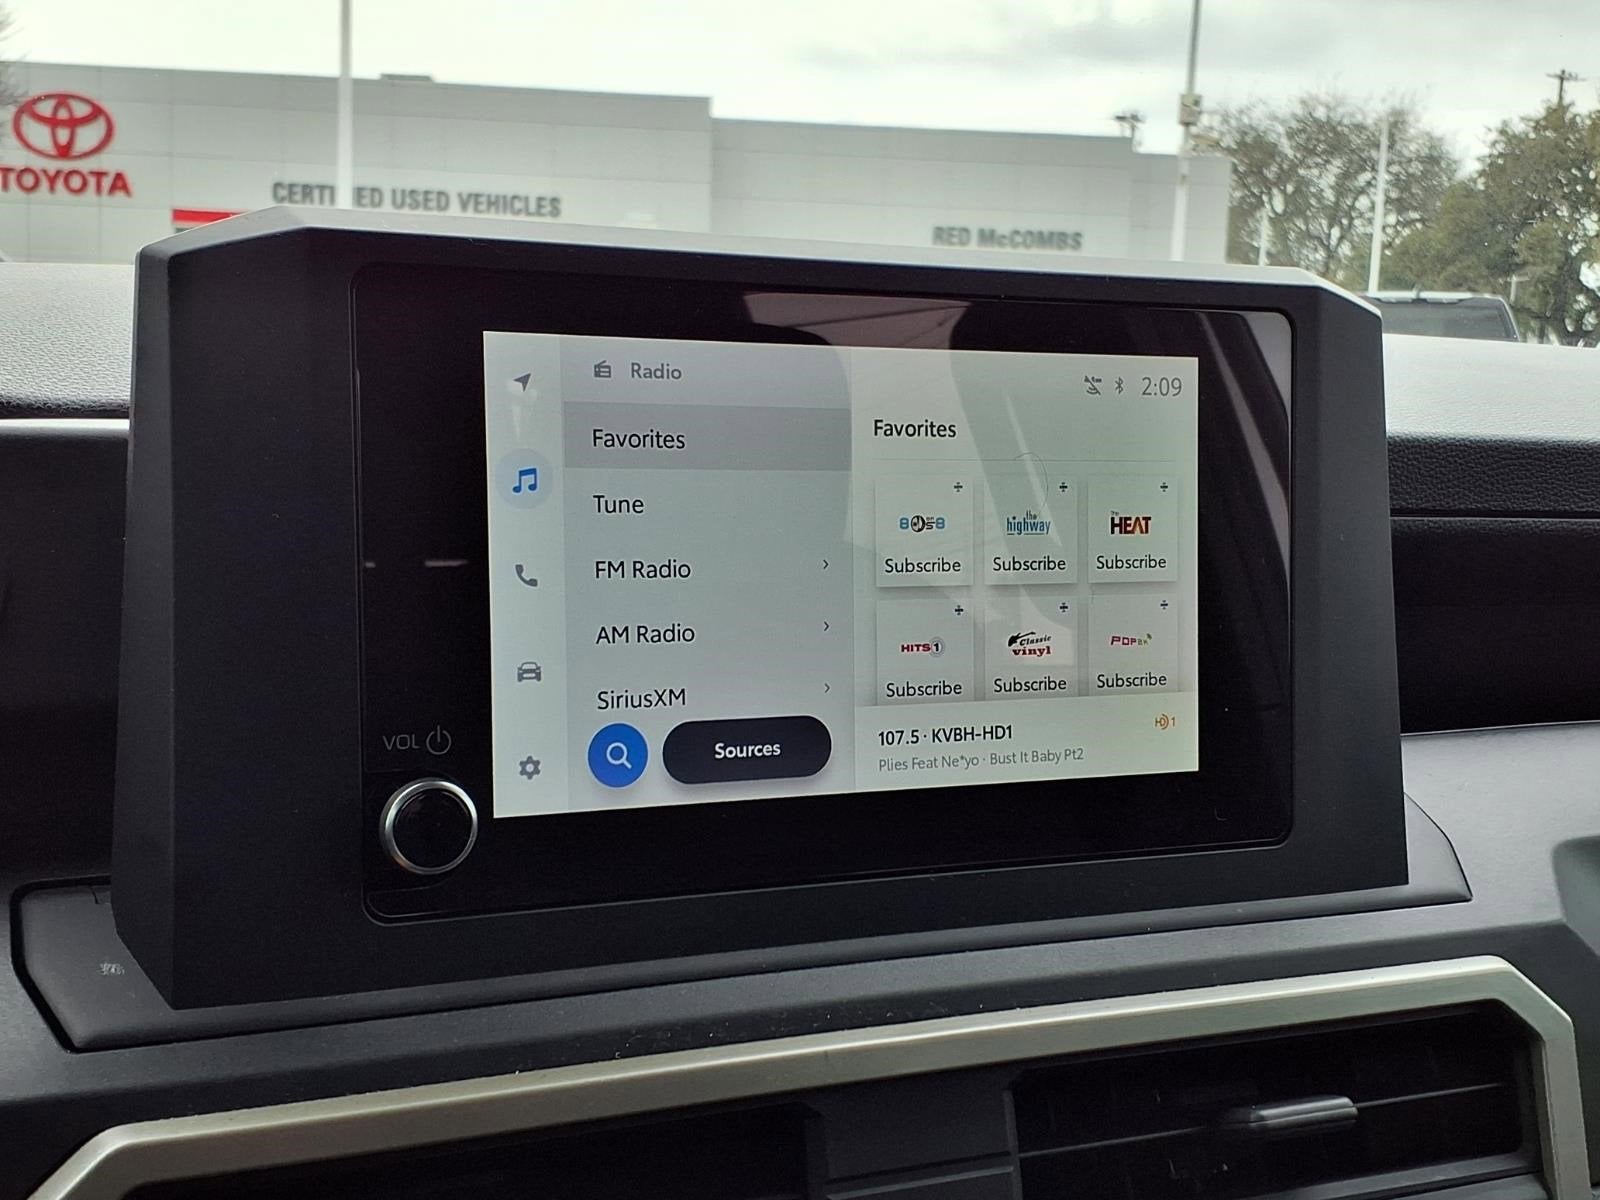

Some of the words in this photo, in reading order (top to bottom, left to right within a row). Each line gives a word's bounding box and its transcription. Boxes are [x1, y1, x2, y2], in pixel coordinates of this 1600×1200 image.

[0, 166, 132, 197] TOYOTA
[273, 182, 383, 209] CERTIED
[391, 187, 450, 212] USED
[457, 191, 561, 218] VEHICLES
[933, 226, 971, 247] RED
[978, 228, 1083, 251] McCOMBS
[631, 362, 682, 380] Radio
[1142, 376, 1182, 397] 2:09
[874, 419, 957, 438] Favorites
[593, 429, 686, 449] Favorites
[593, 495, 645, 514] Tune
[1007, 516, 1051, 535] highway
[1110, 516, 1152, 534] HEAT
[595, 561, 625, 579] FM
[632, 559, 691, 578] Radio
[884, 557, 961, 573] Subscribe
[993, 557, 1066, 572] Subscribe
[1096, 554, 1167, 570] Subscribe
[596, 626, 629, 644] AM
[637, 624, 695, 643] Radio
[1019, 634, 1052, 647] Classic
[901, 643, 930, 653] HITS
[1012, 646, 1051, 657] vinyl
[886, 681, 963, 698] Subscribe
[994, 677, 1067, 693] Subscribe
[1097, 672, 1167, 689] Subscribe
[597, 688, 686, 710] SiriusXM
[382, 734, 420, 750] VOL
[878, 730, 920, 746] 107.5
[932, 725, 1012, 743] KVBH-HD1
[714, 743, 781, 759] Sources
[879, 759, 908, 772] Plies
[911, 757, 938, 770] Feat
[990, 752, 1017, 765] Bust
[1020, 751, 1029, 763] It
[1032, 749, 1062, 764] Baby
[1064, 748, 1084, 761] Pt2
